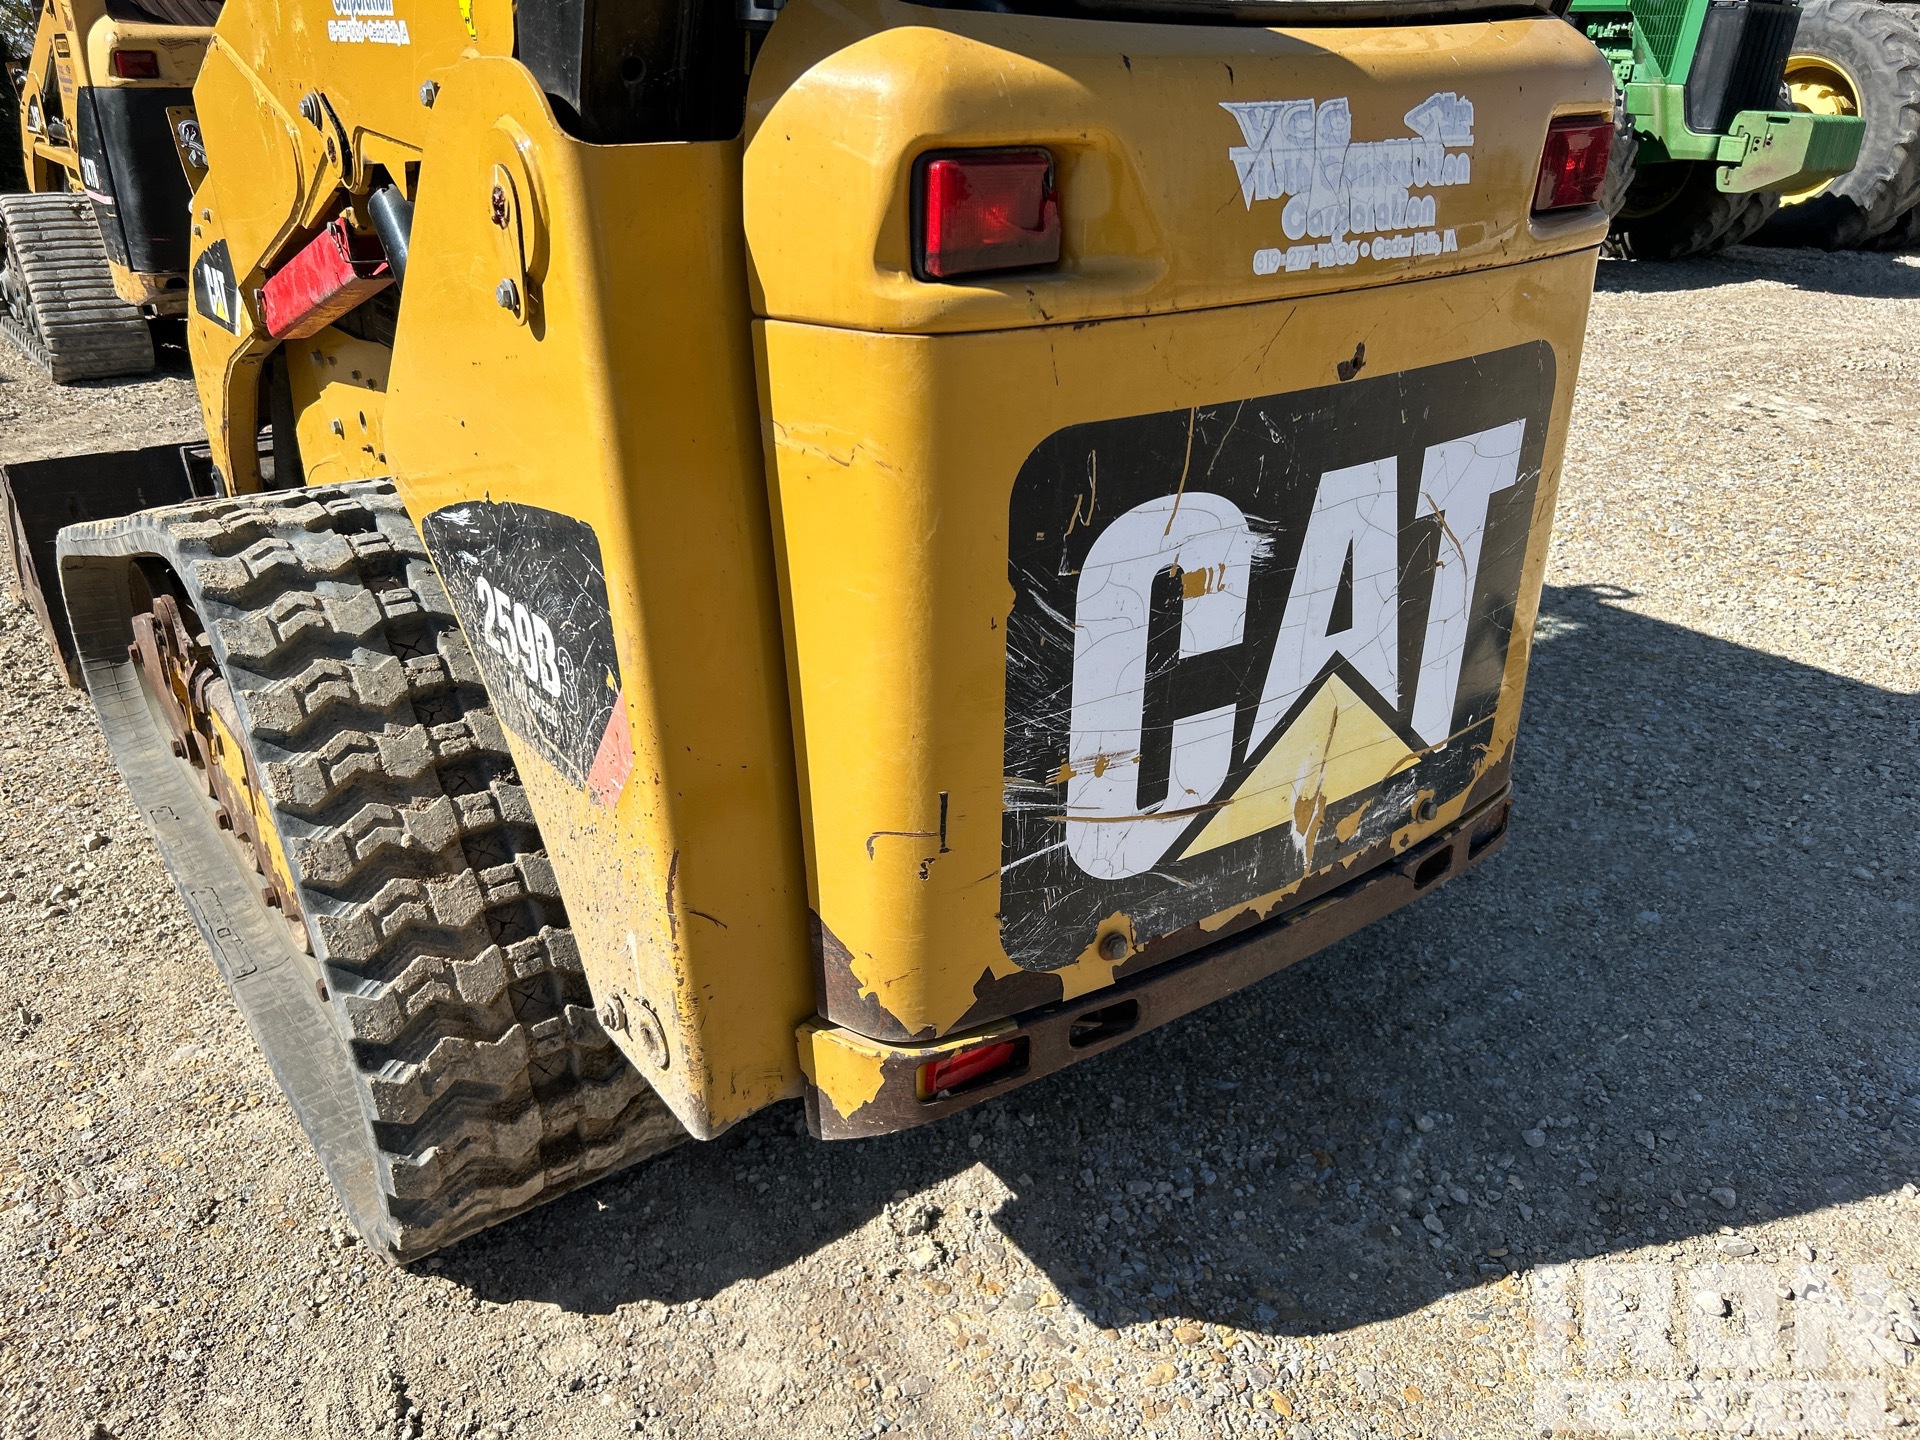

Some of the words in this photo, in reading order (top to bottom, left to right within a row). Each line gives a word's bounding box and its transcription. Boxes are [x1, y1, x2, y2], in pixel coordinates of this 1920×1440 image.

[1318, 149, 1470, 191] Construction
[1282, 189, 1436, 243] Corporation
[1255, 242, 1359, 273] 319-277-1006
[1372, 236, 1412, 258] Cedar
[1444, 230, 1456, 251] IA
[203, 263, 230, 323] CAT
[477, 576, 561, 698] 259B
[557, 646, 580, 715] 3
[1067, 417, 1527, 880] CAT
[528, 686, 558, 727] SPEED
